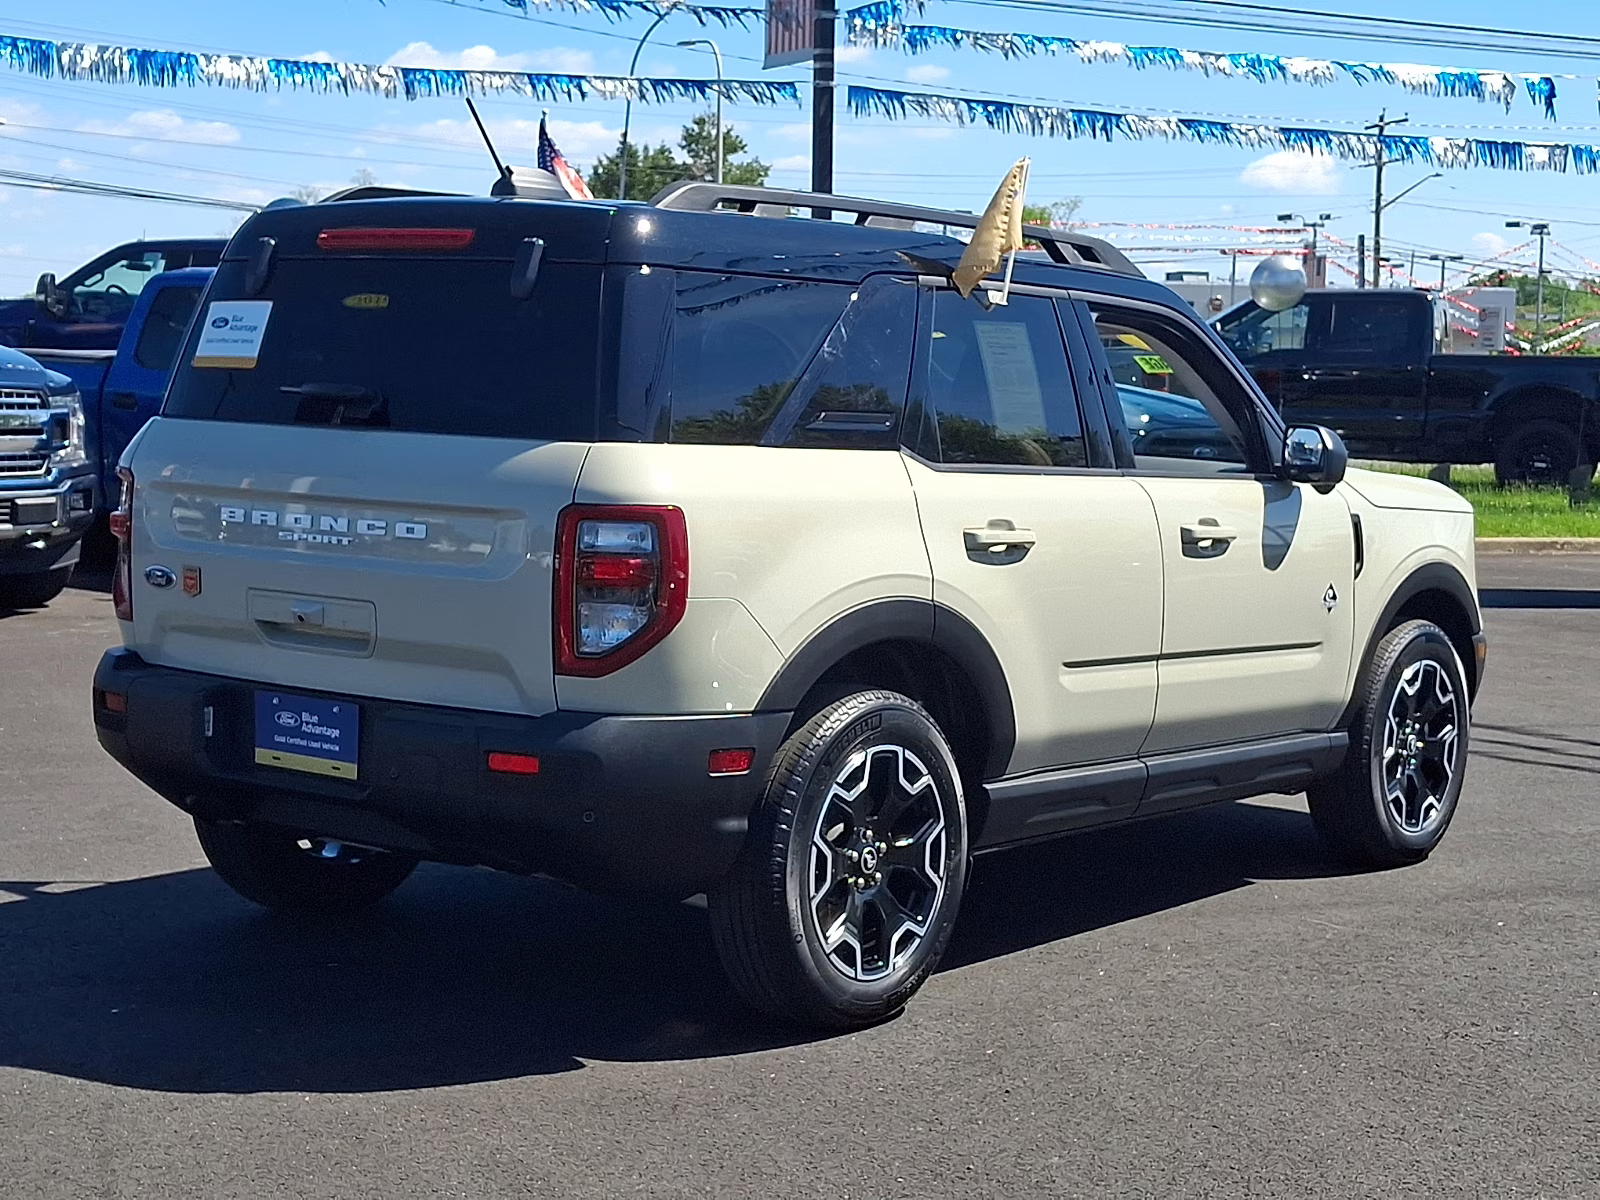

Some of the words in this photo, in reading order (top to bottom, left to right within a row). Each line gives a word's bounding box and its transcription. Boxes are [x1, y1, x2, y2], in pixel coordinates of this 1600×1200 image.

[220, 507, 427, 539] BRONCO
[278, 531, 353, 546] SPORT
[277, 712, 297, 726] Ford
[302, 712, 319, 723] Blue
[302, 722, 340, 738] Advantage
